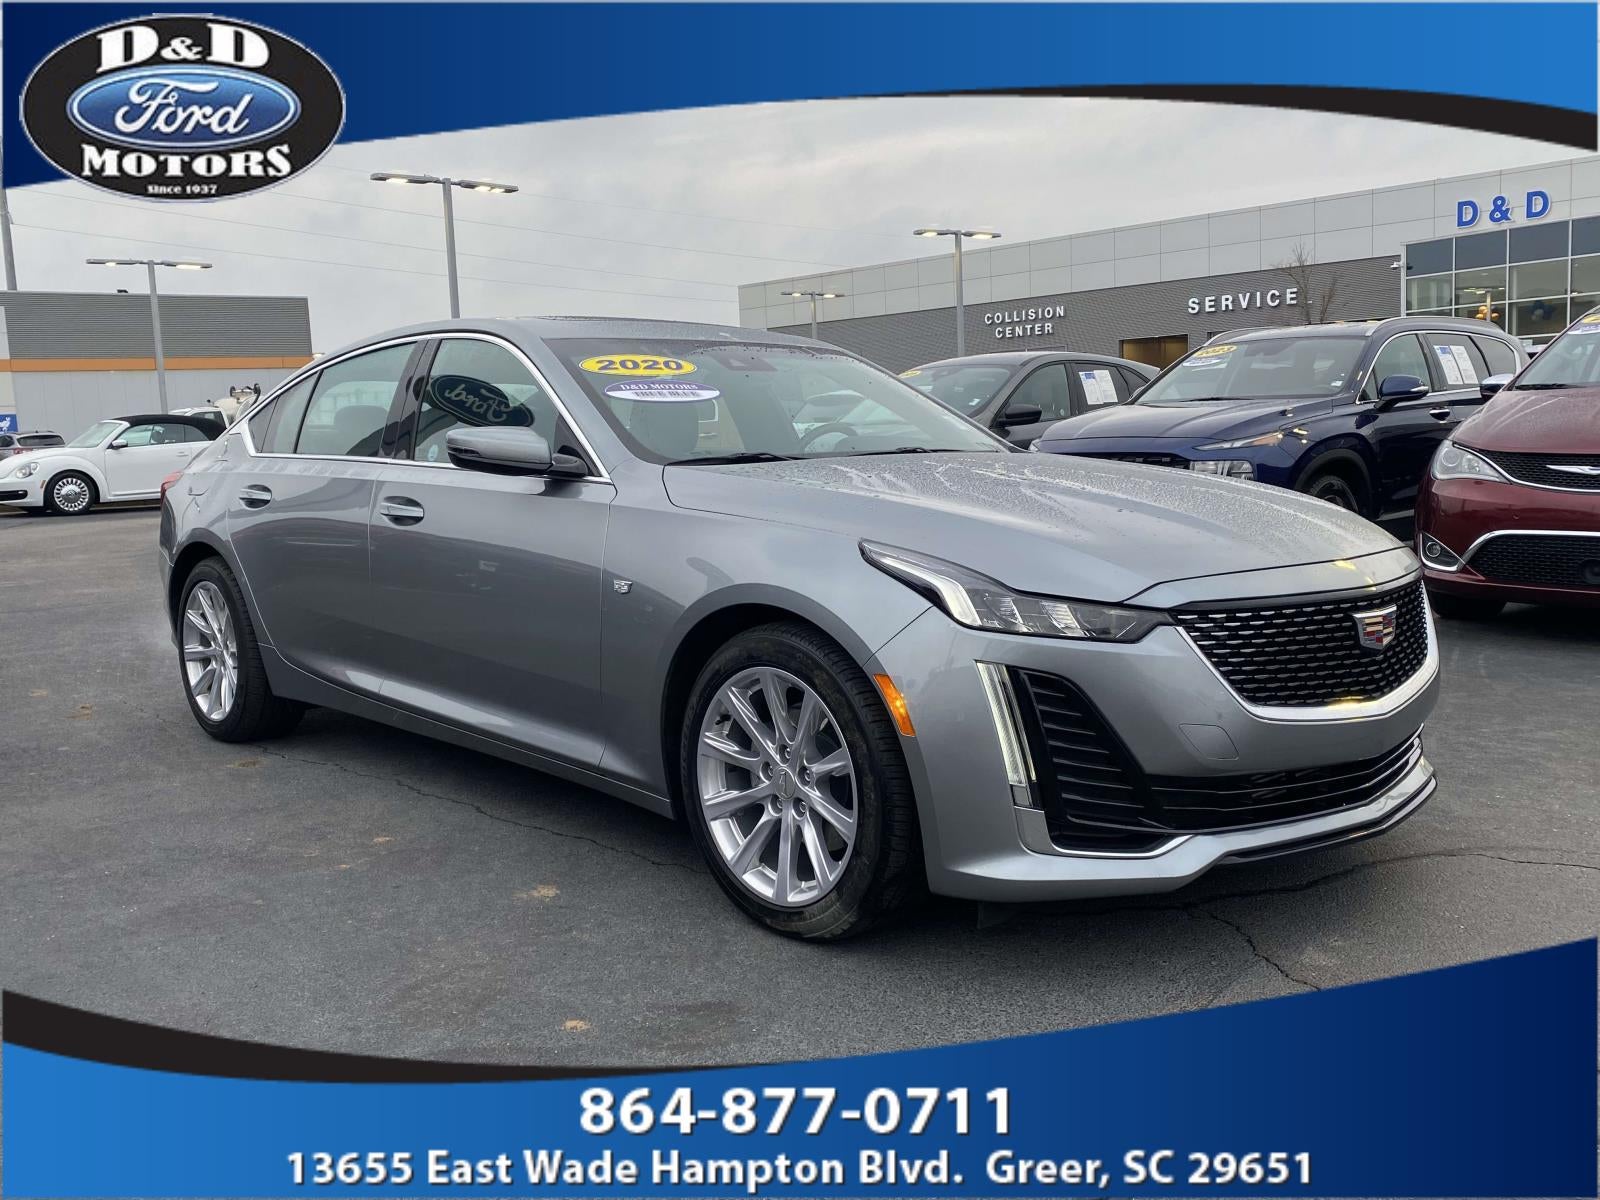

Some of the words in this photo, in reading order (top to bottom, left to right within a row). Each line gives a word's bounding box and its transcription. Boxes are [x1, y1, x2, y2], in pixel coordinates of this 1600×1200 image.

[1456, 200, 1480, 228] D
[1489, 195, 1512, 223] &
[1526, 190, 1551, 219] D
[1188, 287, 1299, 315] SERVICE
[984, 304, 1066, 325] COLLISION
[994, 322, 1055, 339] CENTER
[595, 359, 683, 371] 2020
[650, 383, 698, 391] MOTORS
